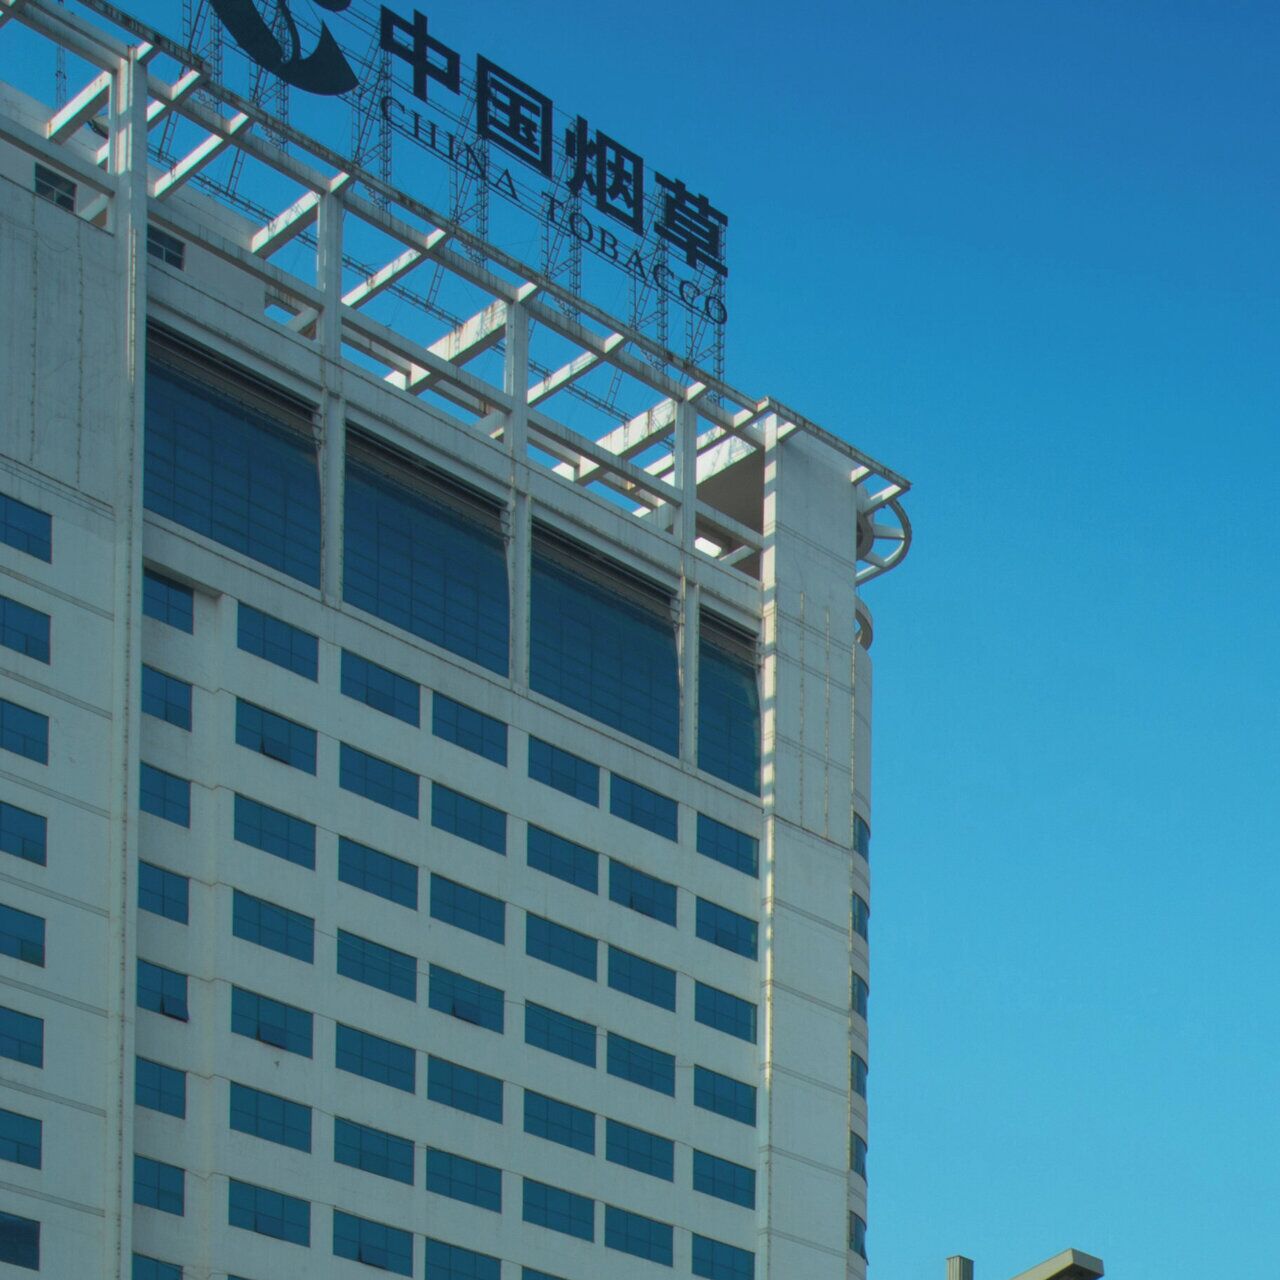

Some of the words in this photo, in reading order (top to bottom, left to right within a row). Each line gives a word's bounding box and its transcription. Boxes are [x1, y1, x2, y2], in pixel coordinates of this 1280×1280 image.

[379, 95, 519, 201] CHINA
[541, 189, 728, 326] TOBACCO
[380, 4, 729, 278] 中国烟草
